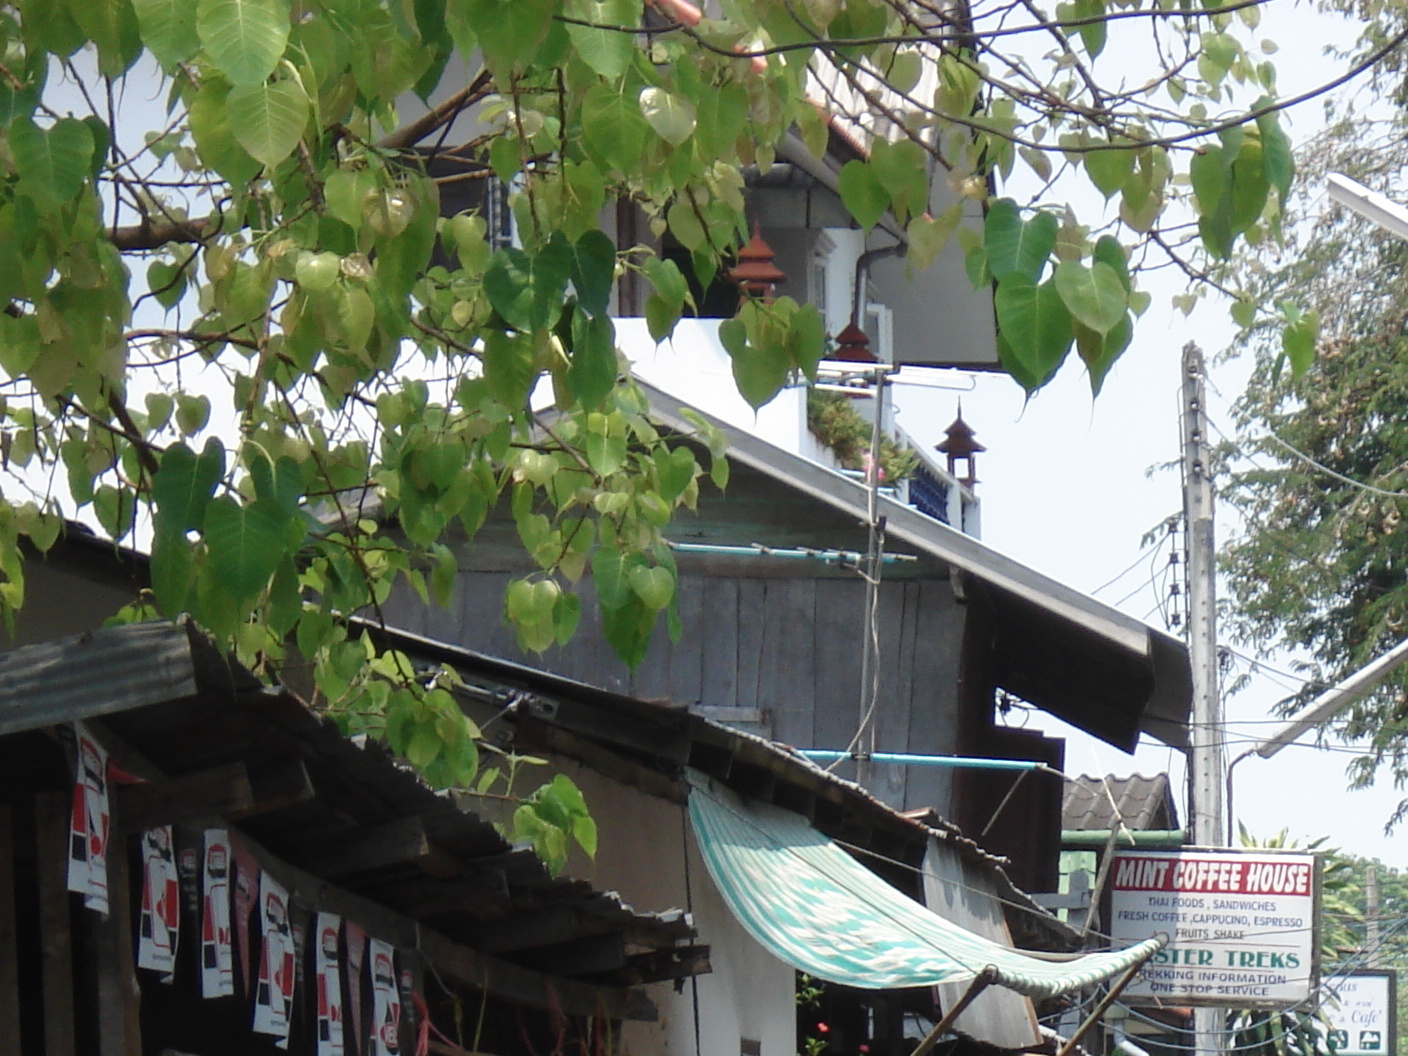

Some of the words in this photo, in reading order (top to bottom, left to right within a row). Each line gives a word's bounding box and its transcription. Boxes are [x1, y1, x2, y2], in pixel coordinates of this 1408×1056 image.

[1115, 859, 1169, 889] MINT
[1173, 861, 1242, 891] COFFEE
[1247, 863, 1308, 893] HOUSE
[1149, 897, 1169, 907] THAI
[1172, 898, 1204, 908] FOODS
[1213, 899, 1276, 912] SANDWICHES
[1118, 910, 1149, 921] FRESH
[1152, 913, 1188, 923] COFFEE
[1254, 916, 1303, 928] ESPRESSO
[1175, 928, 1209, 939] FRUITS
[1213, 929, 1244, 940] SHAKE
[1224, 950, 1300, 969] TREKS
[1198, 972, 1287, 985] INFORMATION
[1151, 982, 1176, 993] ONE
[1180, 984, 1213, 994] STOP
[1217, 985, 1269, 997] SERVICE
